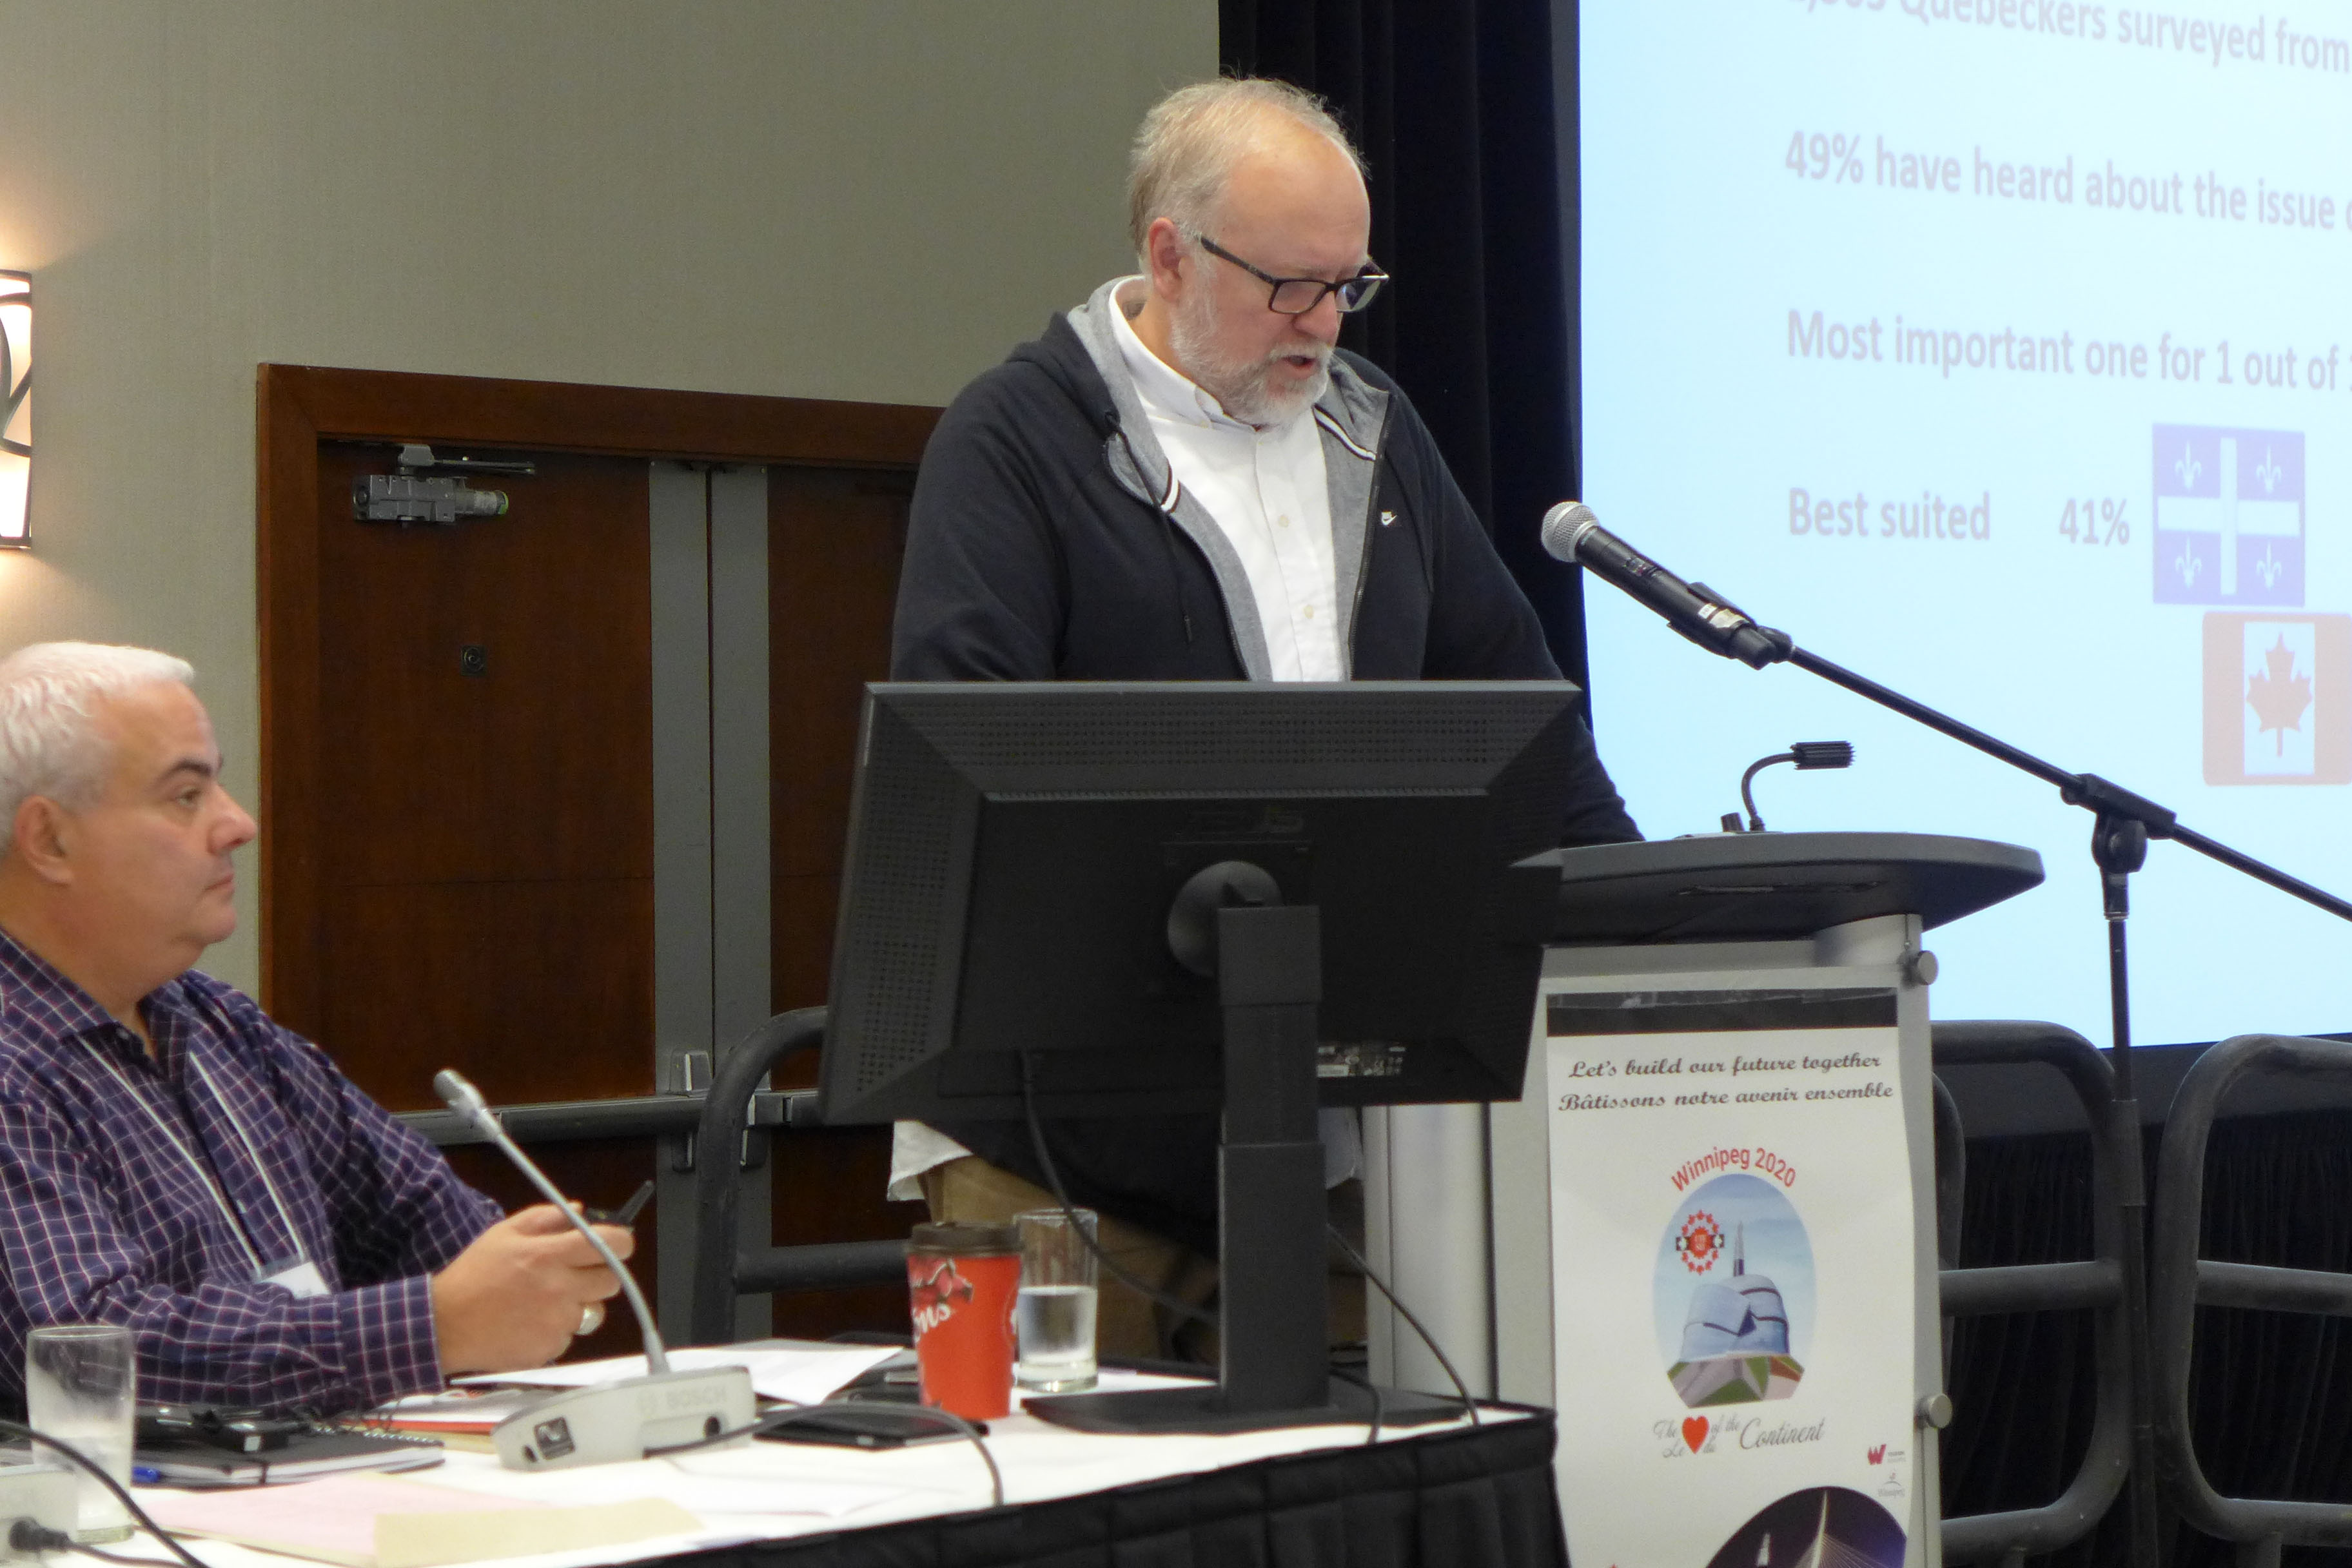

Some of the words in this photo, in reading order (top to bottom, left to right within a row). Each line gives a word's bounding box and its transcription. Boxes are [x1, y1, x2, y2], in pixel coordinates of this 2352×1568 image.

[2117, 8, 2264, 68] surveyed
[2275, 17, 2350, 74] from
[1785, 130, 1865, 184] 49%
[1876, 135, 1961, 193] have
[1974, 145, 2073, 203] heard
[2085, 159, 2184, 214] about
[2194, 170, 2247, 221] the
[2258, 178, 2335, 230] issue
[1788, 308, 1883, 362] Most
[1896, 314, 2074, 378] important
[2085, 340, 2148, 379] one
[2158, 331, 2206, 381] for
[2217, 340, 2234, 384] 1
[2244, 346, 2298, 389] out
[2307, 343, 2340, 392] of
[1788, 487, 1868, 537] Best
[1881, 491, 1990, 540] suited
[2059, 497, 2130, 546] 41%
[1625, 1057, 1681, 1076] build
[1689, 1062, 1726, 1073] our
[1732, 1055, 1797, 1077] future
[1802, 1052, 1881, 1073] together
[1558, 1093, 1666, 1112] Bâtissons
[1674, 1090, 1730, 1106] notre
[1735, 1087, 1798, 1103] avenir
[1805, 1083, 1894, 1101] ensemble
[1671, 1146, 1750, 1191] Winnipeg
[1755, 1147, 1796, 1188] 2020
[1740, 1417, 1827, 1450] Continent
